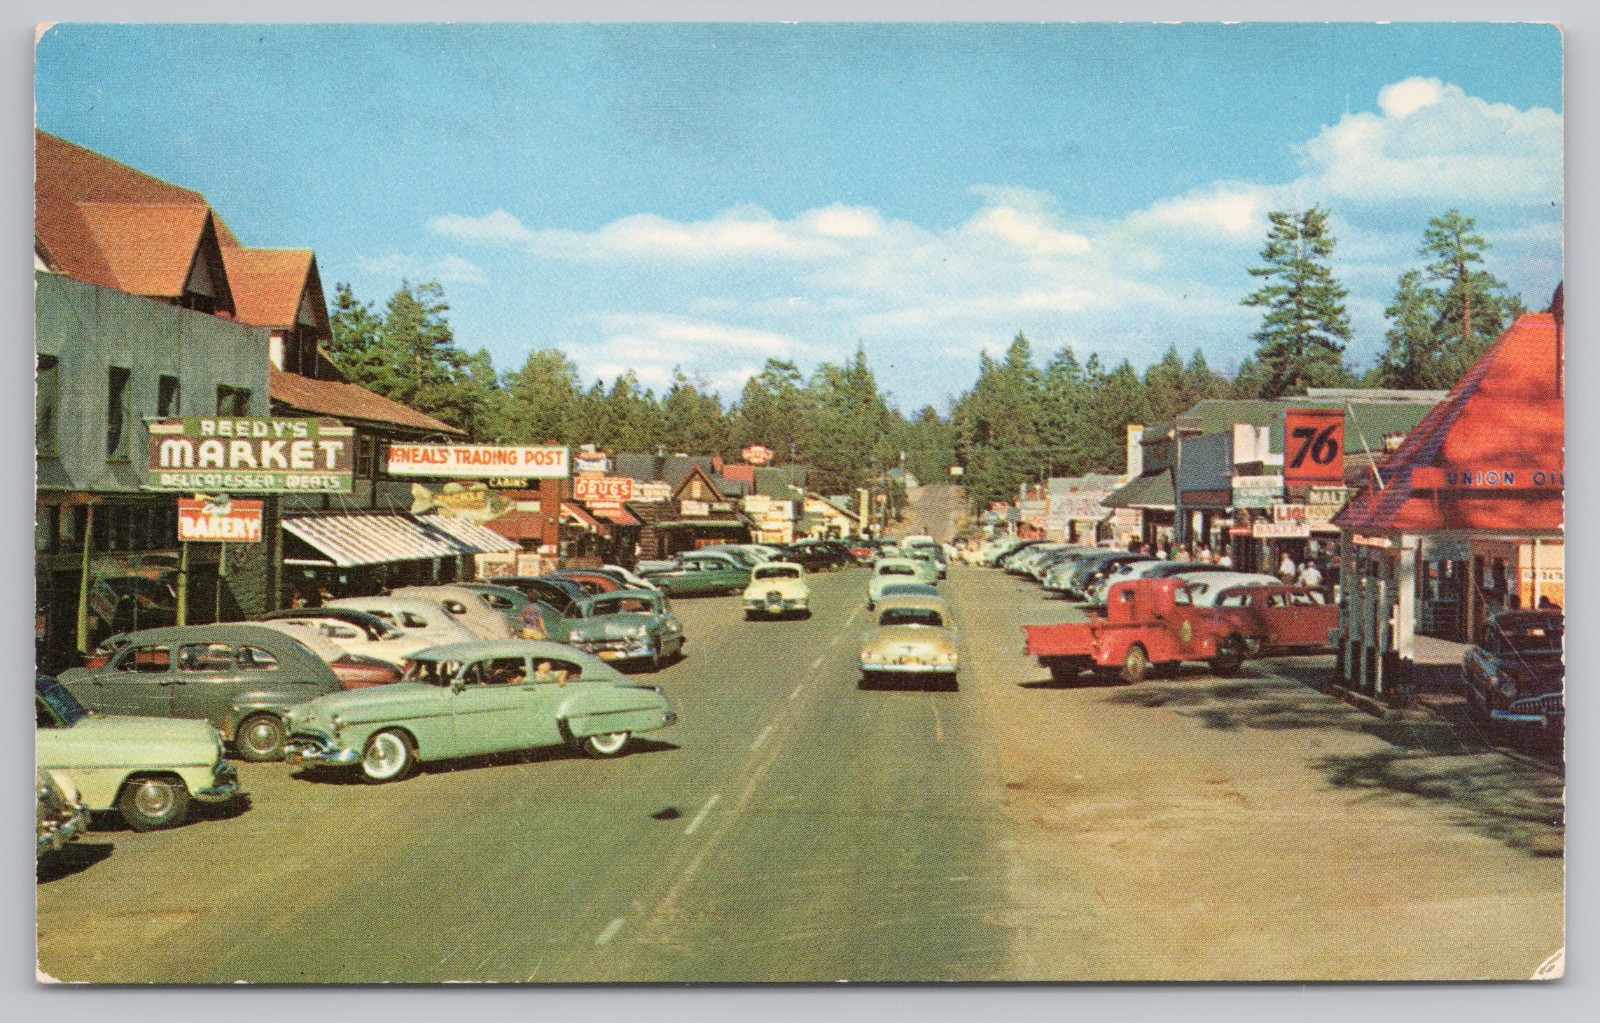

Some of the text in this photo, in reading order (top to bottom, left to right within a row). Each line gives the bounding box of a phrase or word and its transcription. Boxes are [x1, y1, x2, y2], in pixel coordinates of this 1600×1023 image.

[201, 420, 308, 438] REEDY'S
[160, 439, 344, 469] MARKET
[1289, 423, 1341, 468] 76
[453, 449, 518, 466] TRADING
[525, 450, 564, 466] POST
[160, 473, 341, 489] DELICATESSEN MEATS
[488, 477, 529, 488] CABINS
[1446, 470, 1515, 486] UNION
[576, 482, 629, 495] DRUGS
[181, 516, 260, 539] BAKERY
